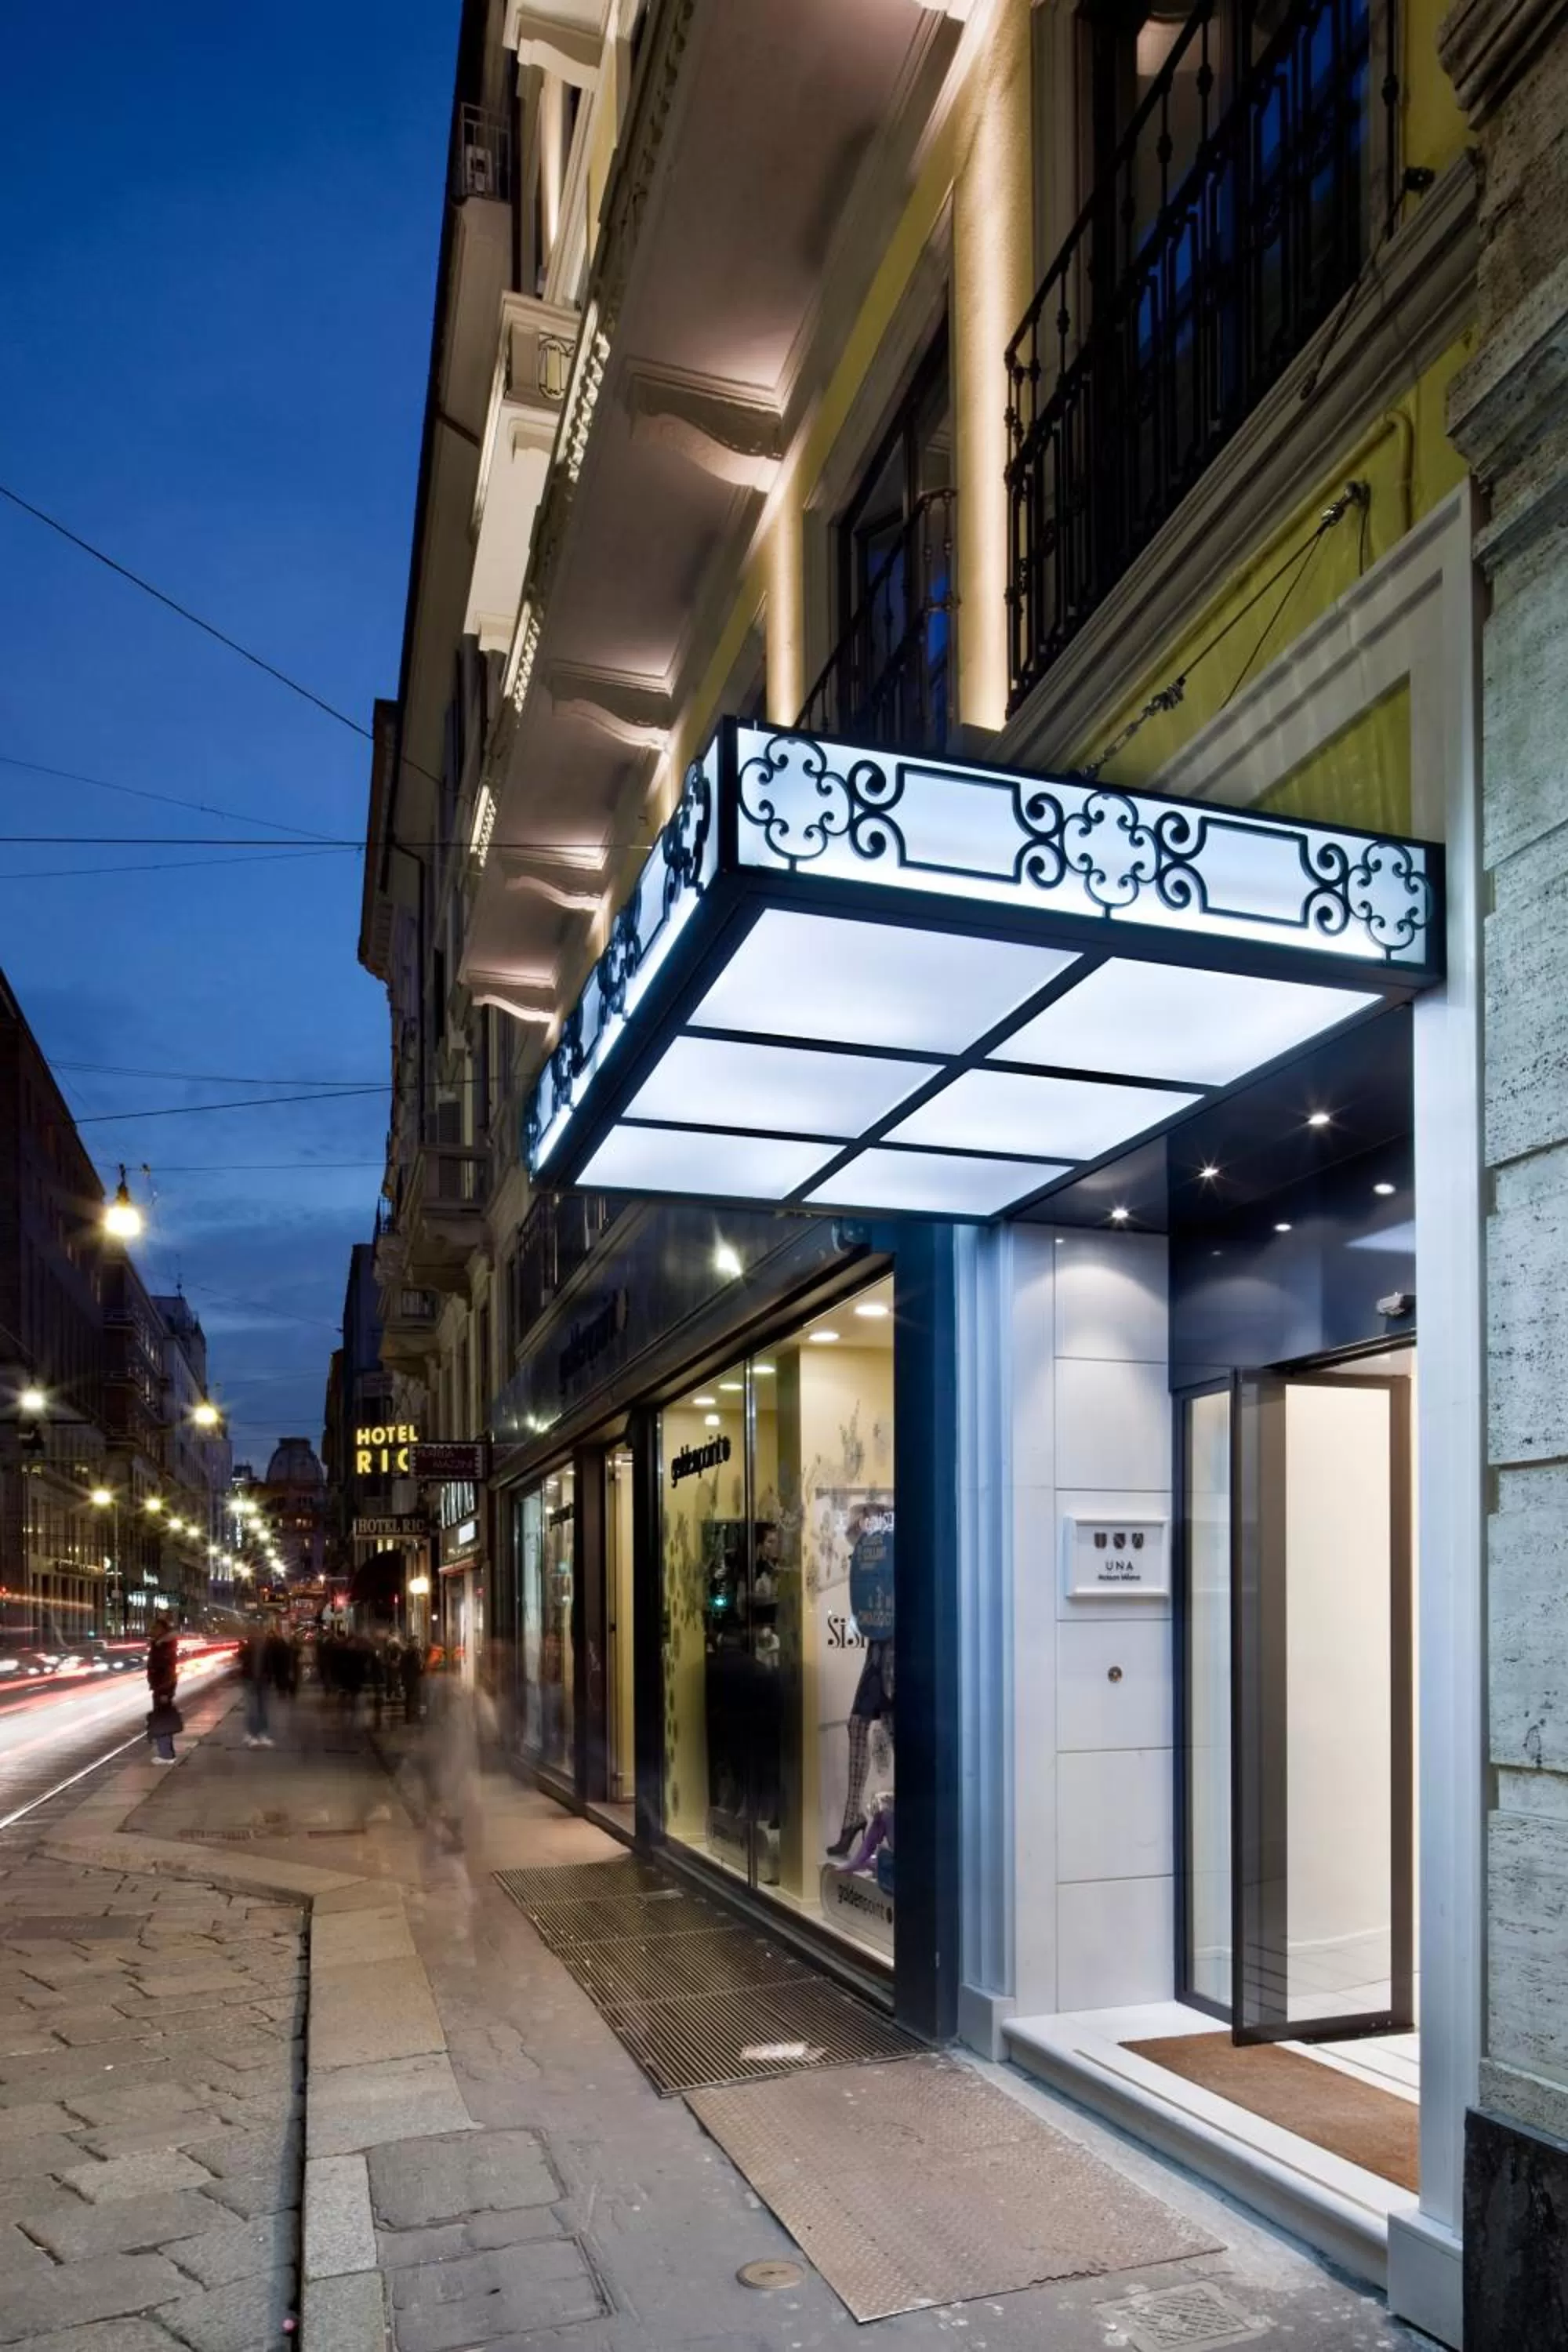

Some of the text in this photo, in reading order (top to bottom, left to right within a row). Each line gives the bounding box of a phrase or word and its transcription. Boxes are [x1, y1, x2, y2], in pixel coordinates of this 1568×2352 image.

[357, 1425, 419, 1445] HOTEL
[359, 1518, 400, 1534] HOTEL
[1105, 1560, 1134, 1571] UNA
